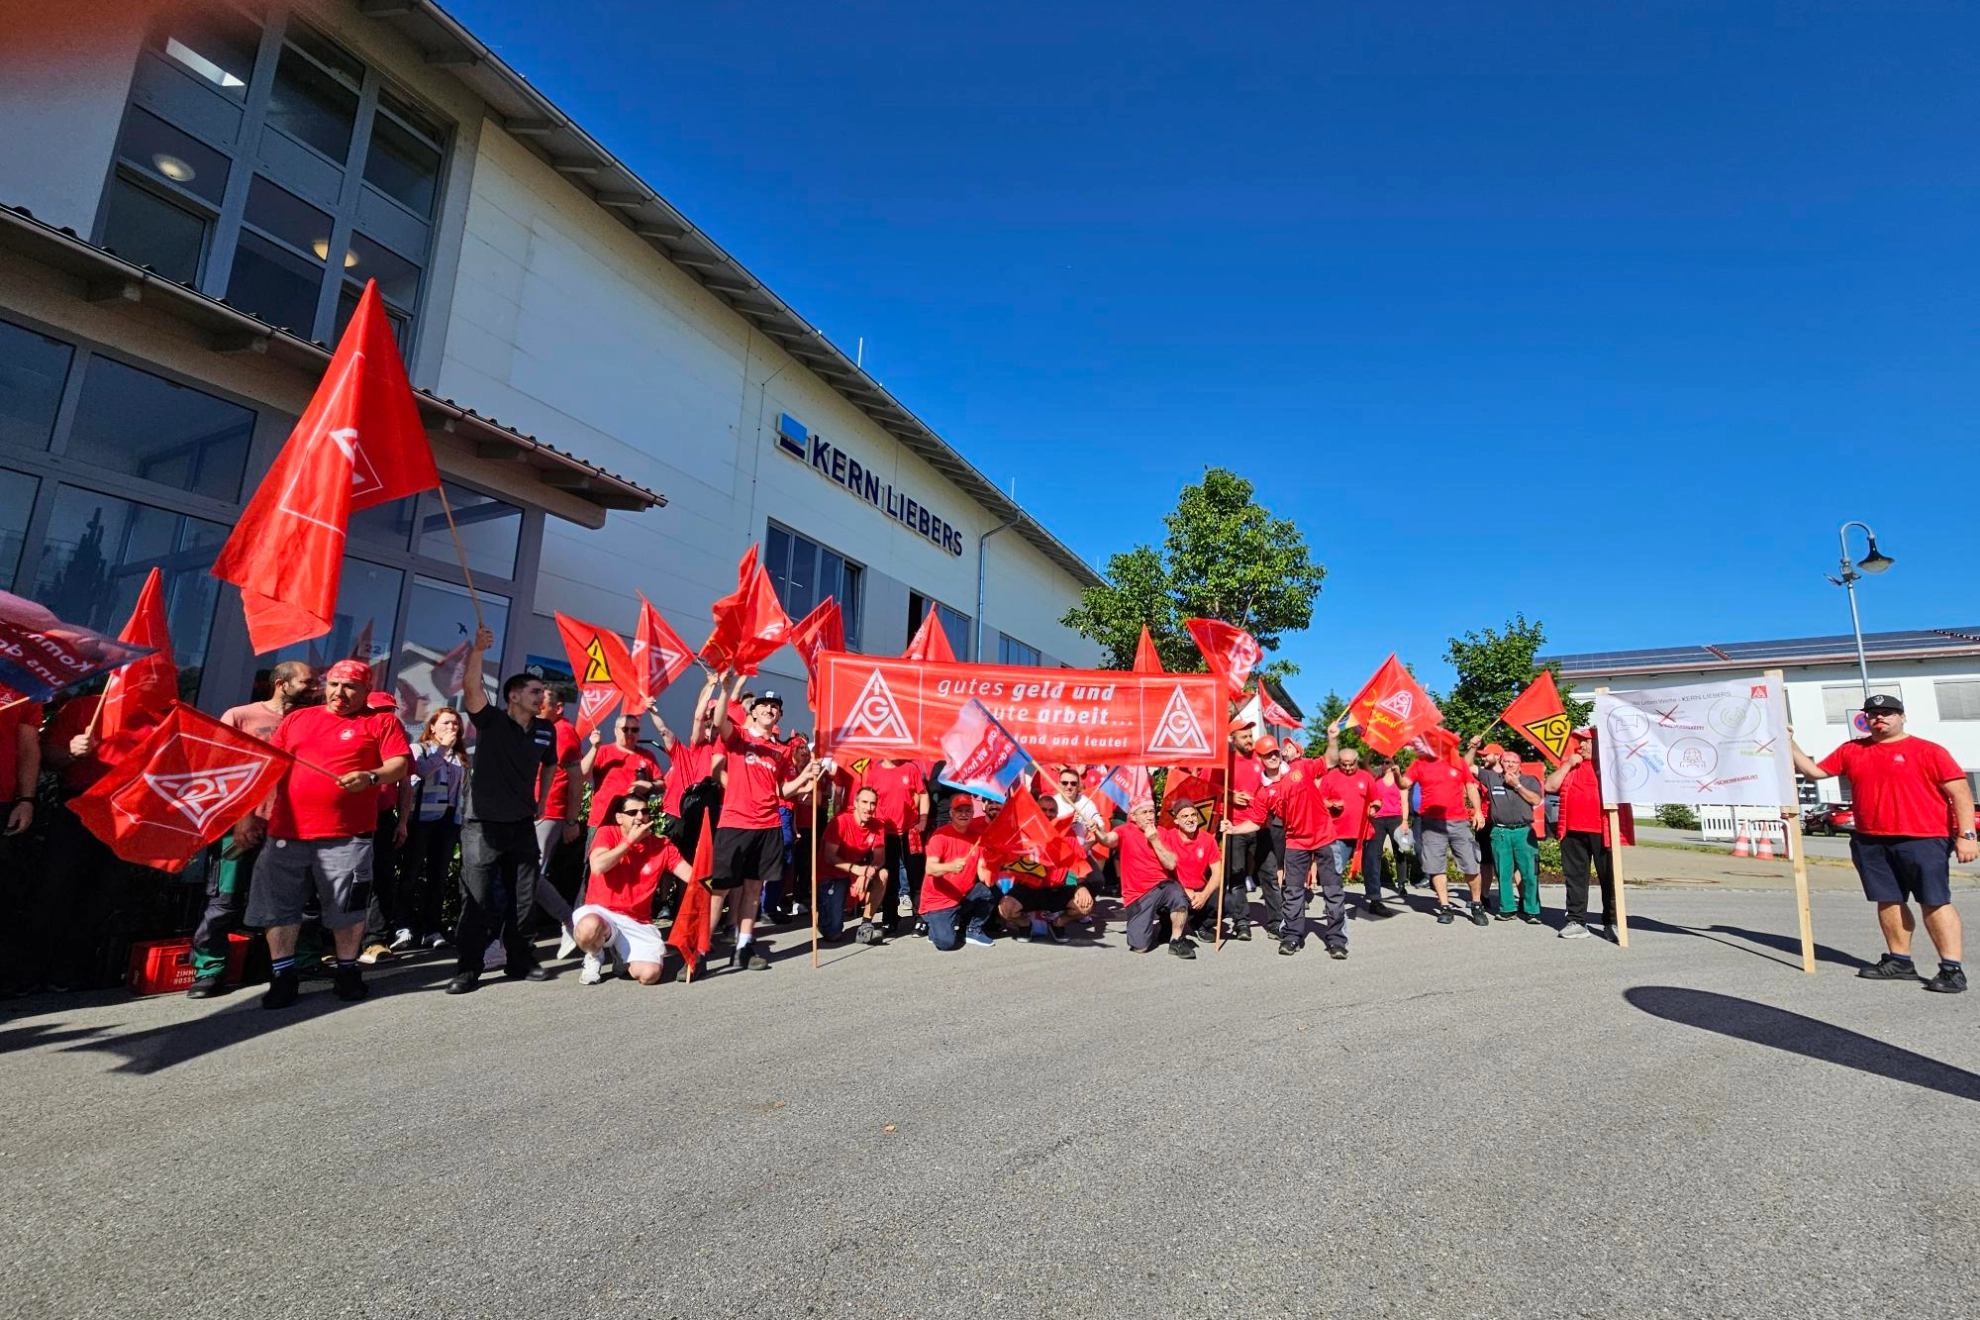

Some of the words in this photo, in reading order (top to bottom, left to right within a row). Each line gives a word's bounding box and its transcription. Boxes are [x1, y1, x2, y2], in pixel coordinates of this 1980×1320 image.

[812, 434, 880, 506] KERN
[886, 484, 963, 557] LIEBERS
[936, 678, 1004, 698] gutes
[1011, 680, 1065, 702] geld
[1072, 683, 1116, 701] und
[985, 704, 1029, 722] ute
[1052, 734, 1079, 746] und
[1084, 735, 1128, 748] leute!
